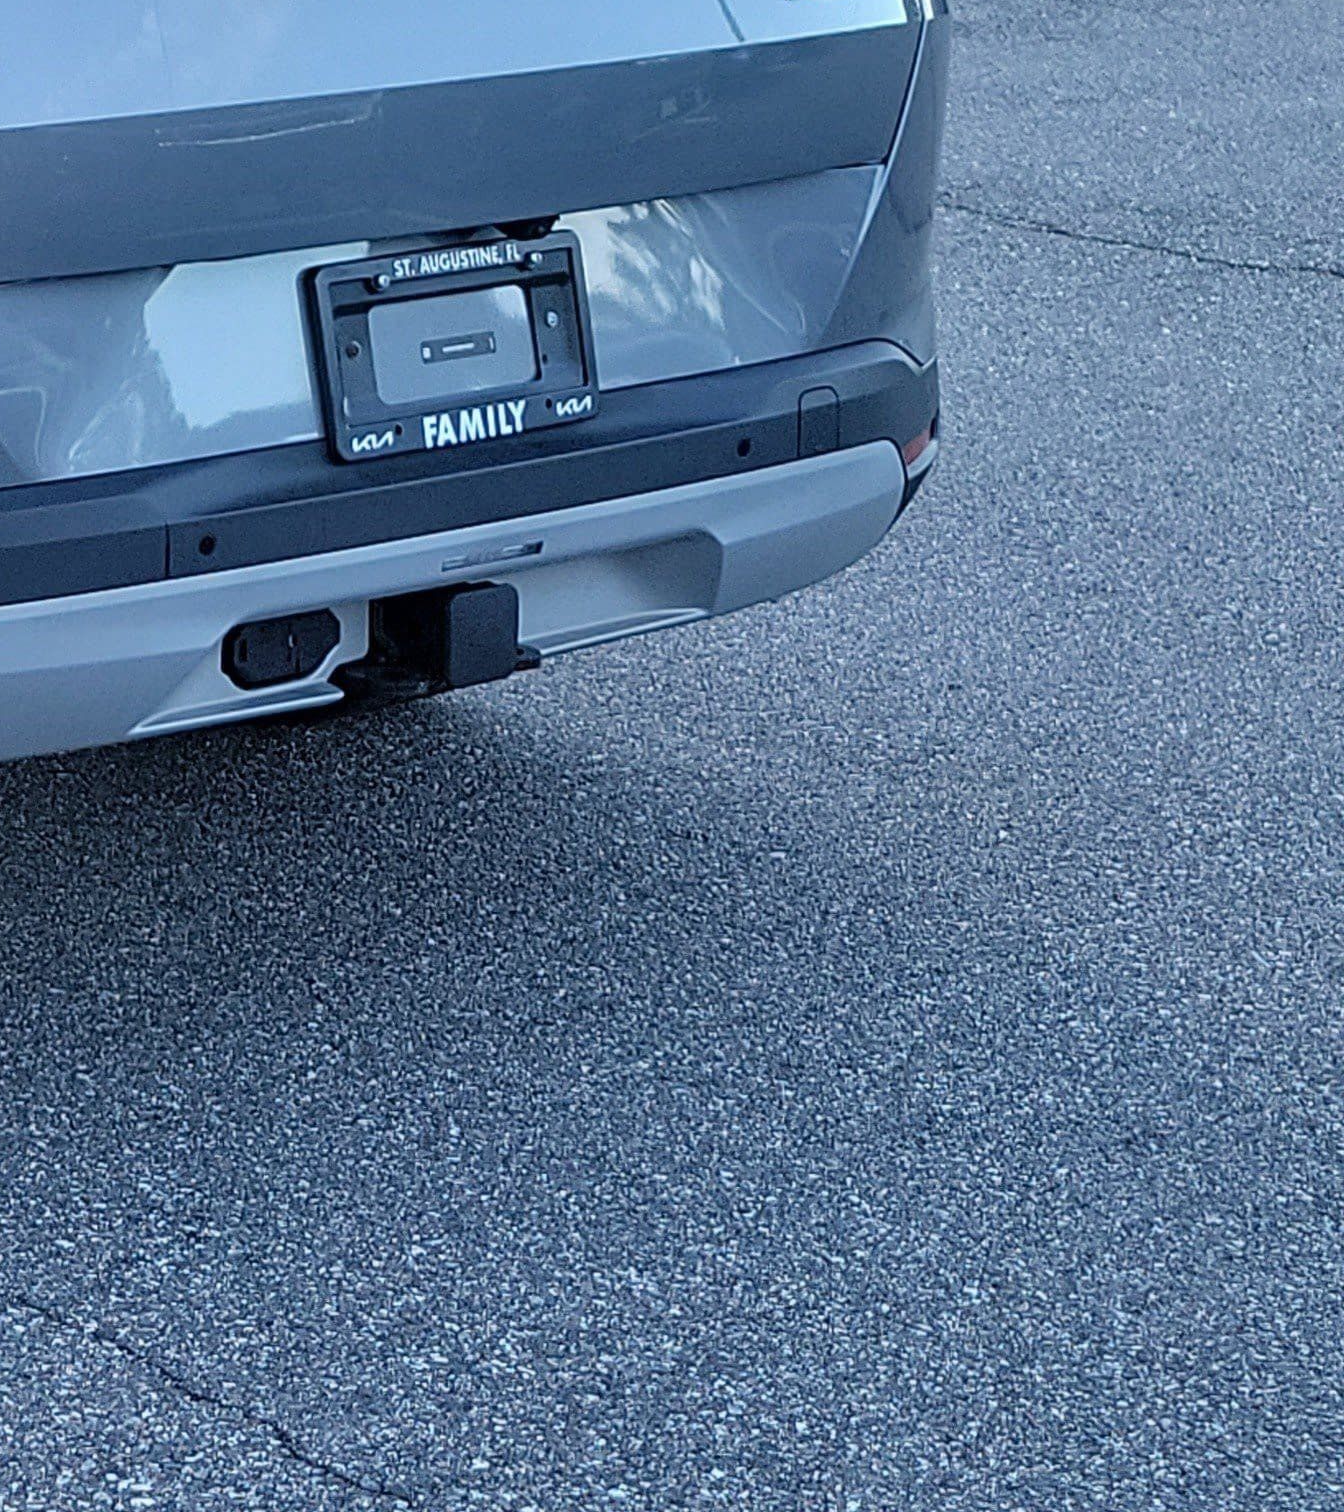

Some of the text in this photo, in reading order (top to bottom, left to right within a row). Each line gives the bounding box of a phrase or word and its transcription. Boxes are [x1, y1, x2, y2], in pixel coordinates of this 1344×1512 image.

[392, 243, 521, 278] ST. AUGUSTINE, FL
[422, 399, 526, 449] FAMILY
